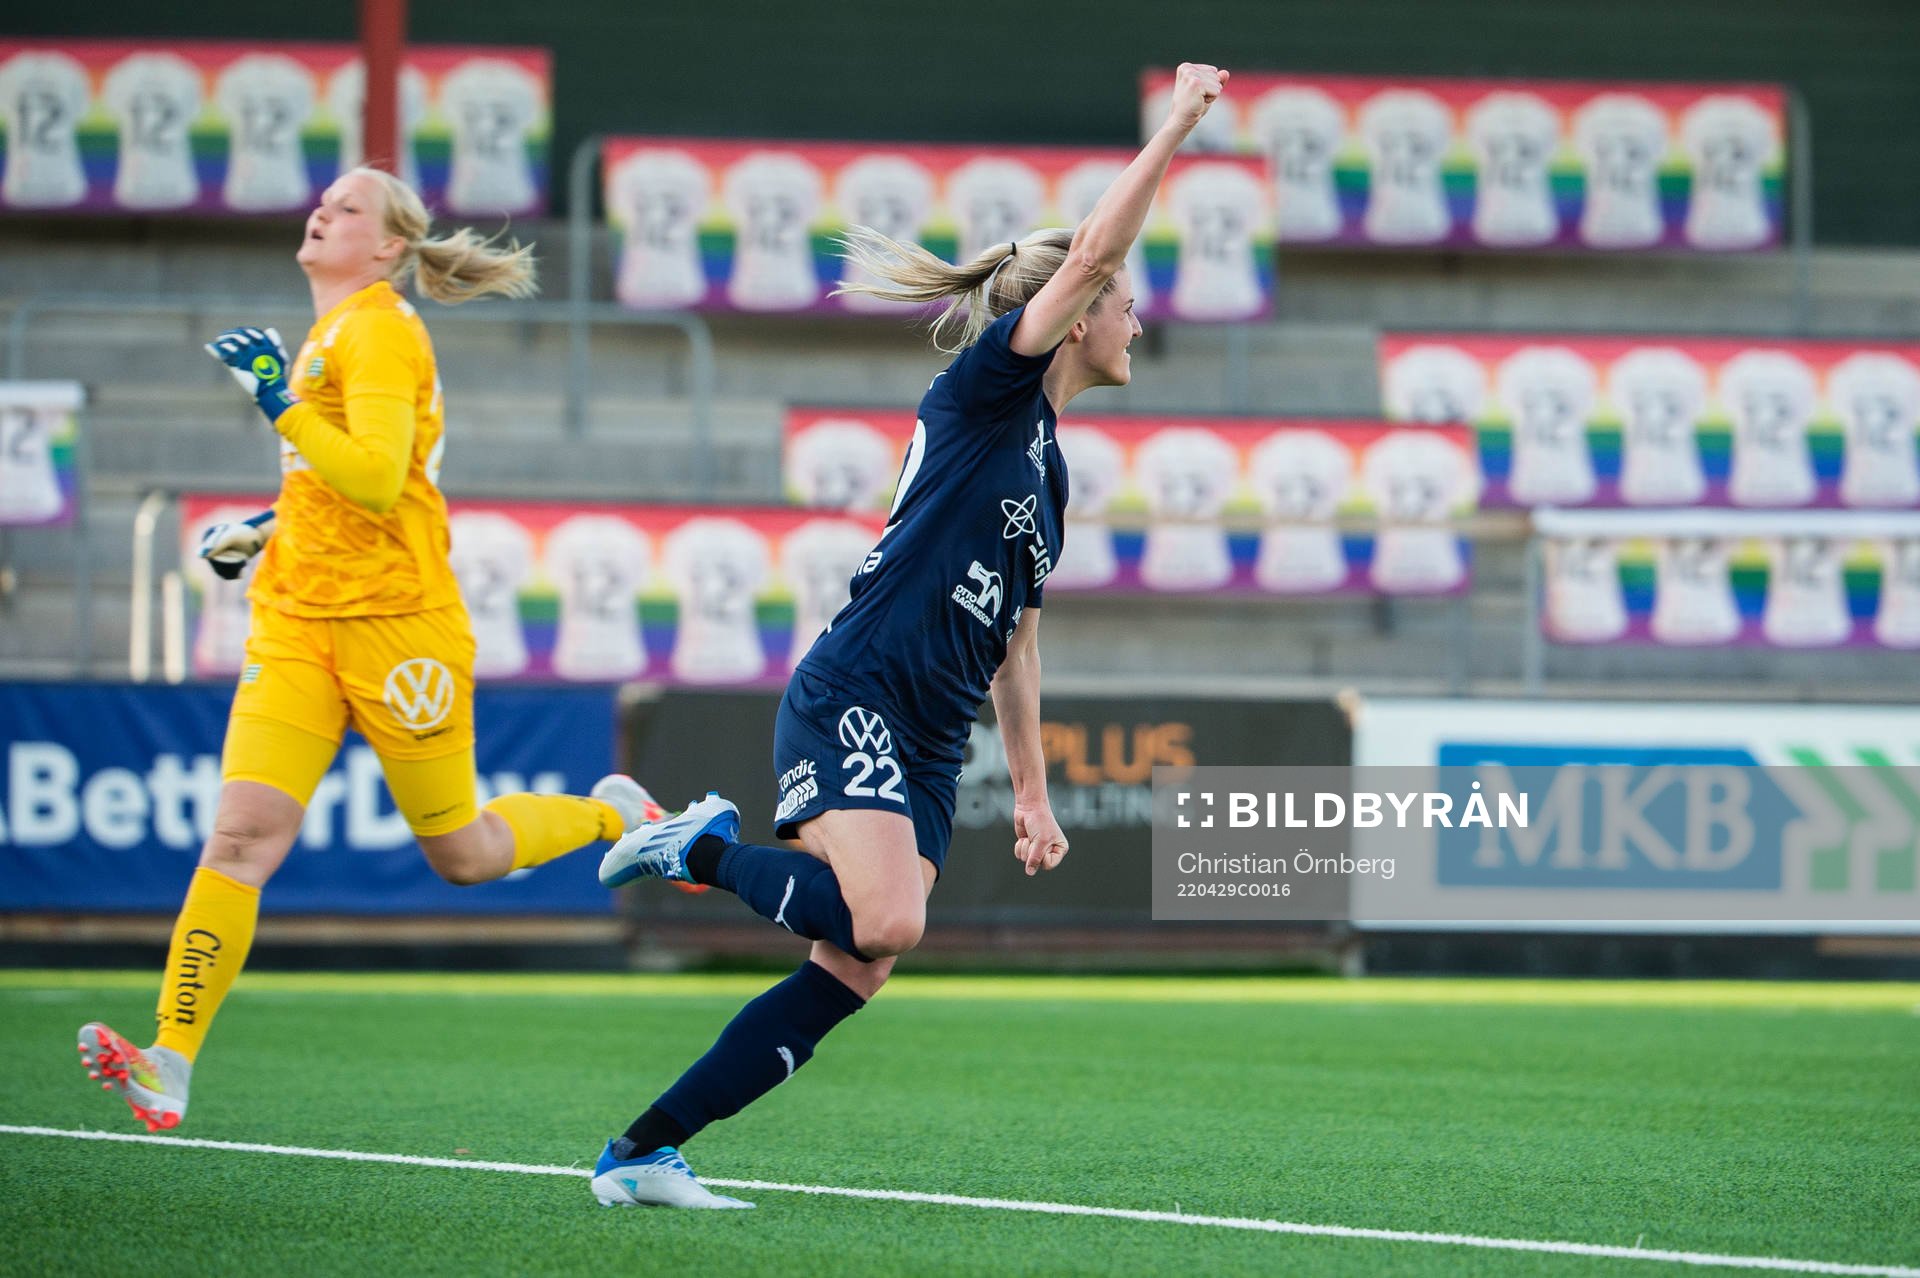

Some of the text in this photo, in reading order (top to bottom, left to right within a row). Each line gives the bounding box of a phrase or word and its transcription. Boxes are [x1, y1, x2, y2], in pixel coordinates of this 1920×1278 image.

[16, 92, 67, 154] 12
[127, 92, 181, 156] 12
[241, 96, 293, 157] 12
[951, 591, 993, 628] MAGNUSSON
[955, 584, 978, 603] OTTO
[842, 751, 905, 803] 22
[1470, 761, 1755, 871] MKB
[175, 928, 222, 1025] Clinton
